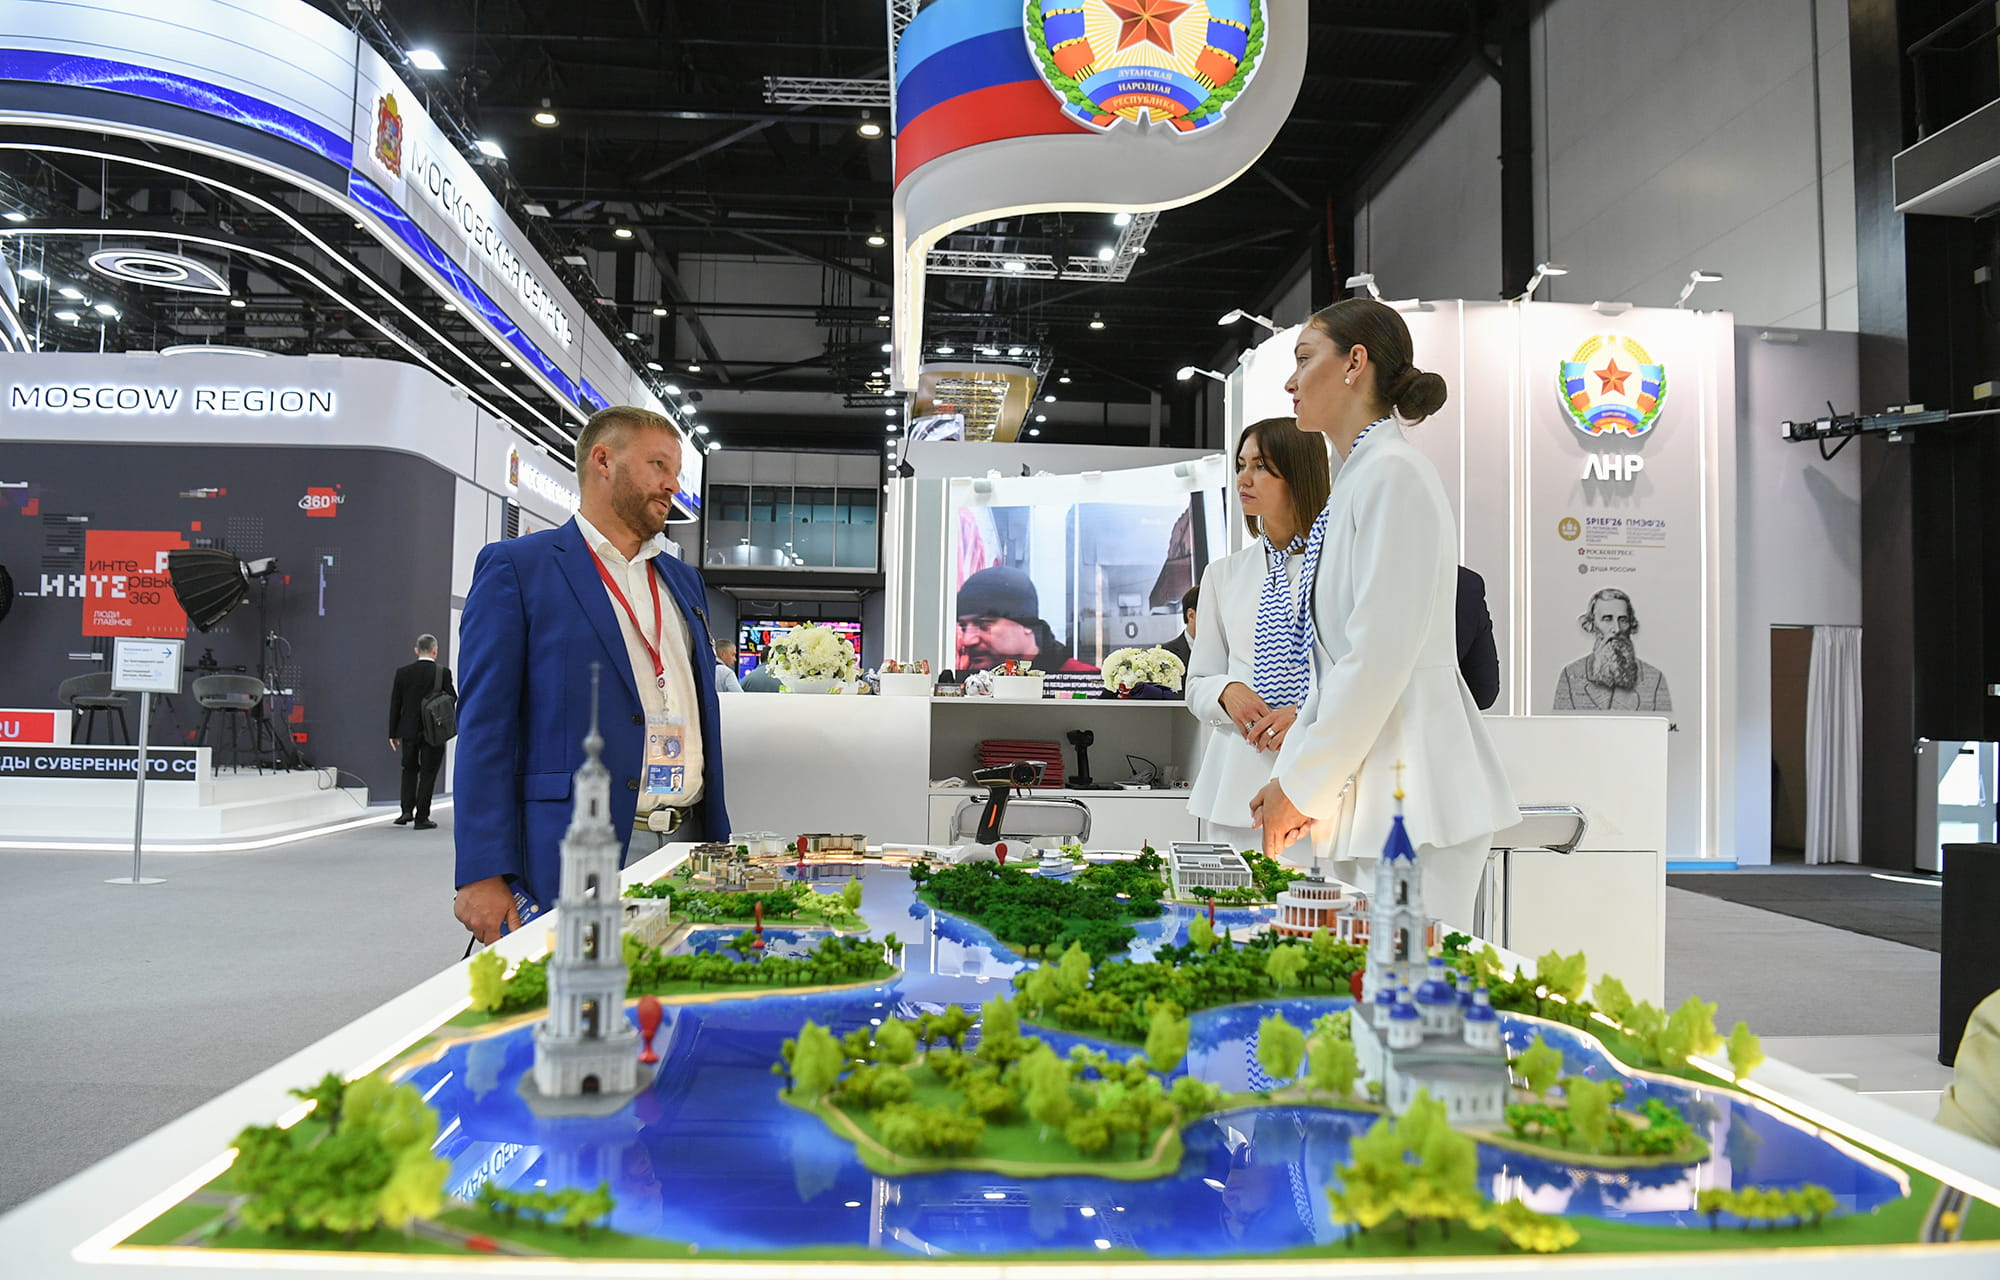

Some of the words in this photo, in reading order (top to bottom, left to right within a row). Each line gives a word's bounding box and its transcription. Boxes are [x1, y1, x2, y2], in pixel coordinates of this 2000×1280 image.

[1118, 68, 1173, 80] ЛУГАНСКАЯ
[1118, 82, 1171, 94] НАРОДНАЯ
[1112, 95, 1175, 111] РЕСПУБЛИКА
[411, 139, 521, 289] МОСКОВСКАЯ
[523, 270, 574, 346] ОБЛАСТЬ
[11, 386, 179, 410] MOSCOW
[194, 389, 333, 413] REGION
[128, 591, 161, 605] 360
